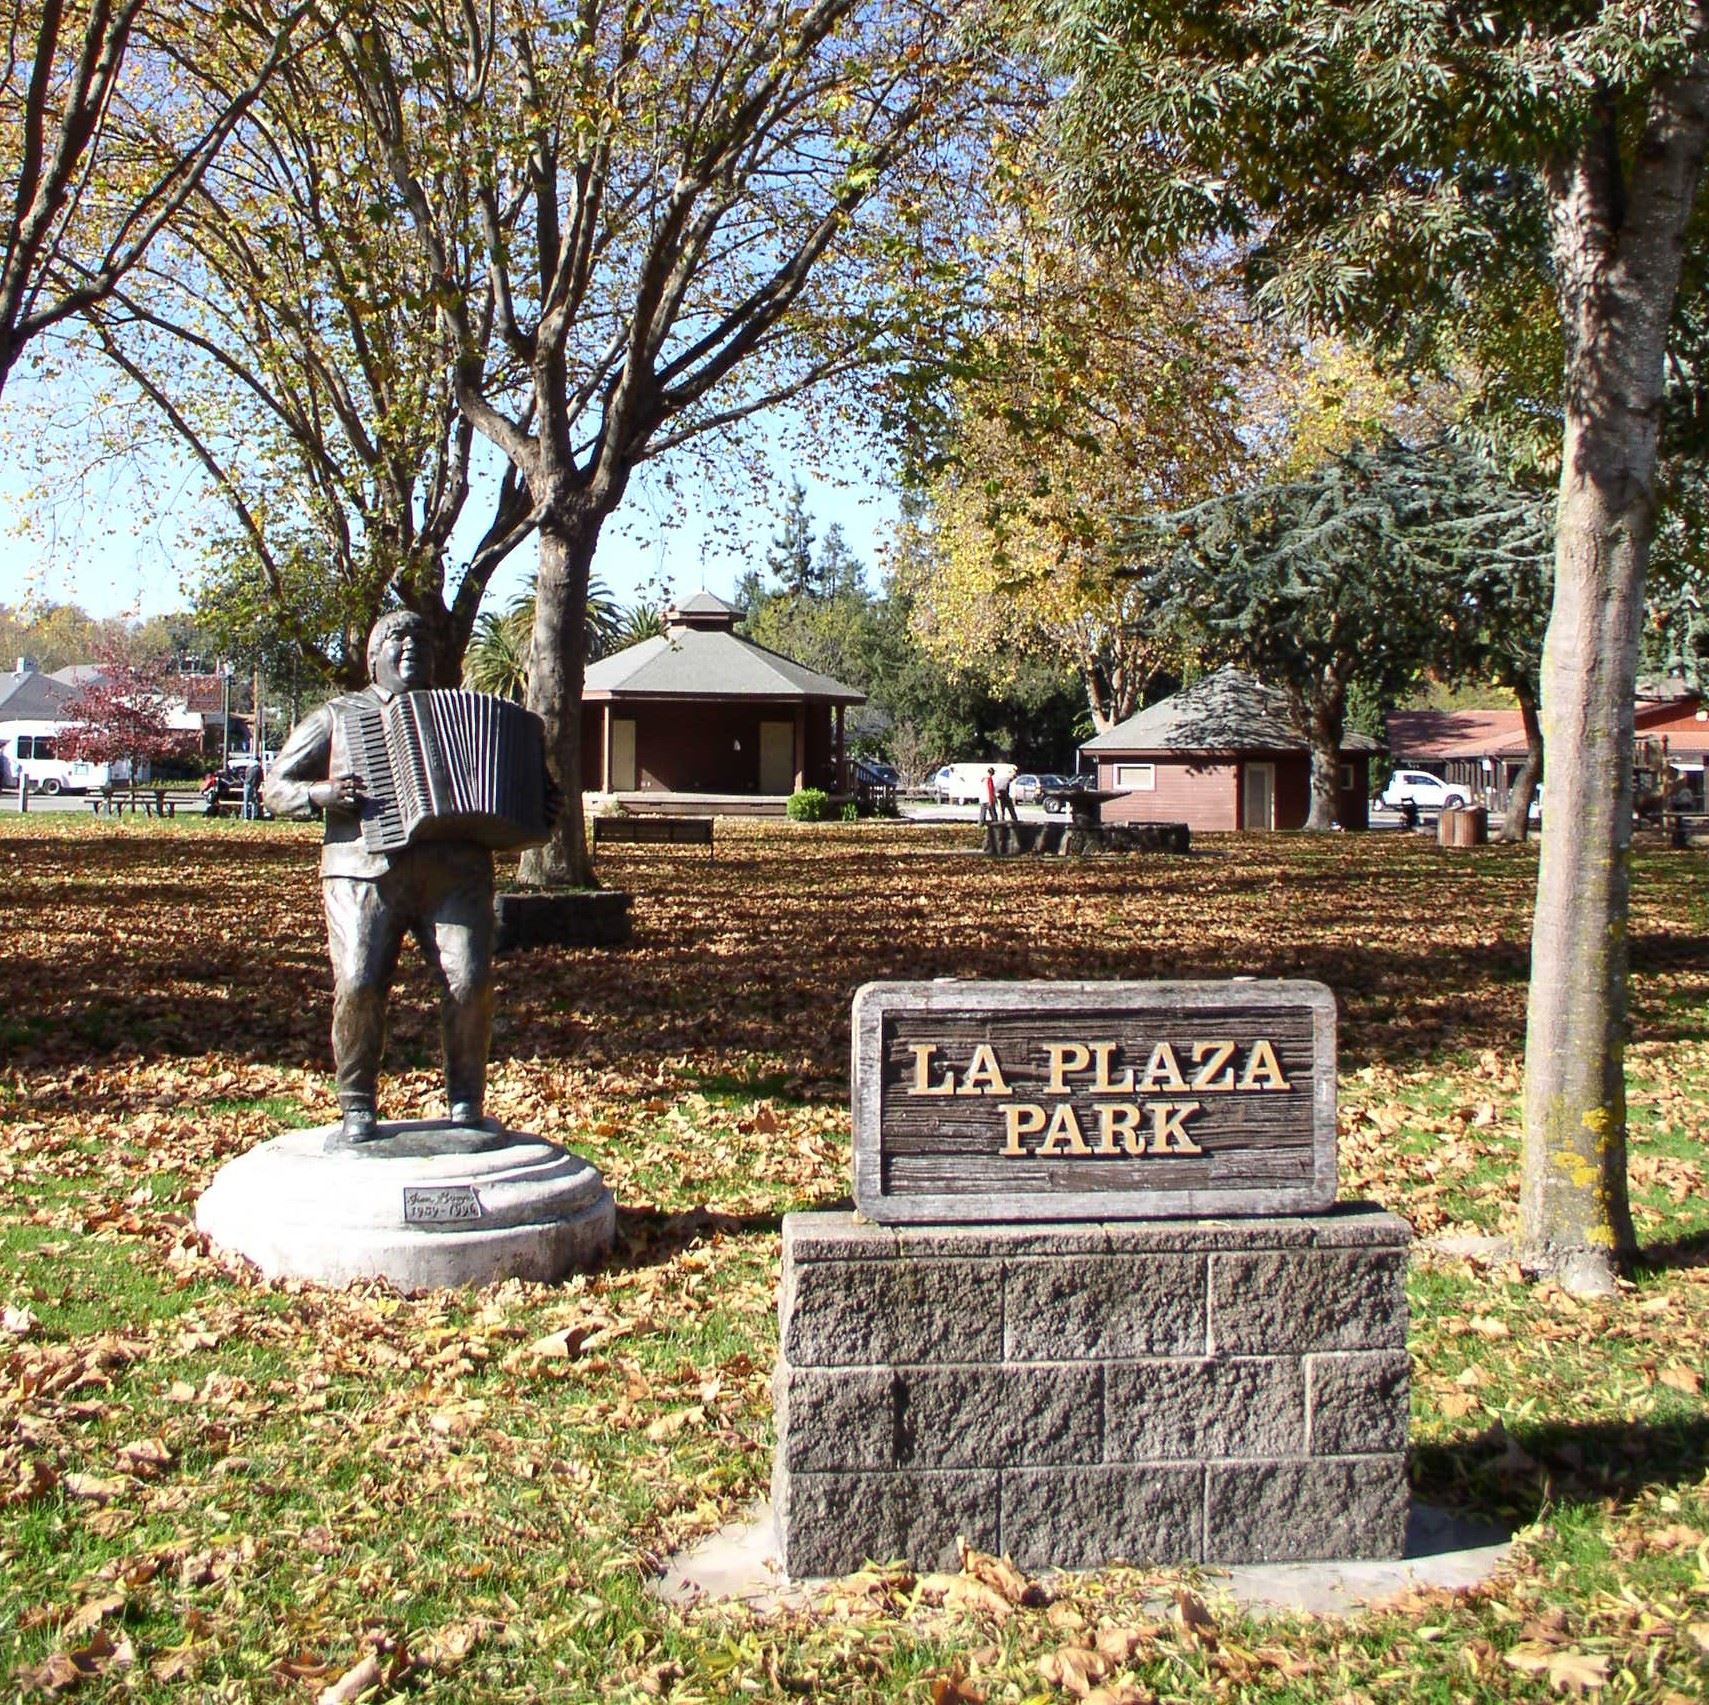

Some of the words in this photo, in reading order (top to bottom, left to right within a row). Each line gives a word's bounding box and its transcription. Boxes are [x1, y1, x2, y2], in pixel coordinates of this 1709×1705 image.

[907, 1043, 1013, 1096] LA
[1042, 1040, 1292, 1095] PLAZA
[998, 1101, 1203, 1157] PARK
